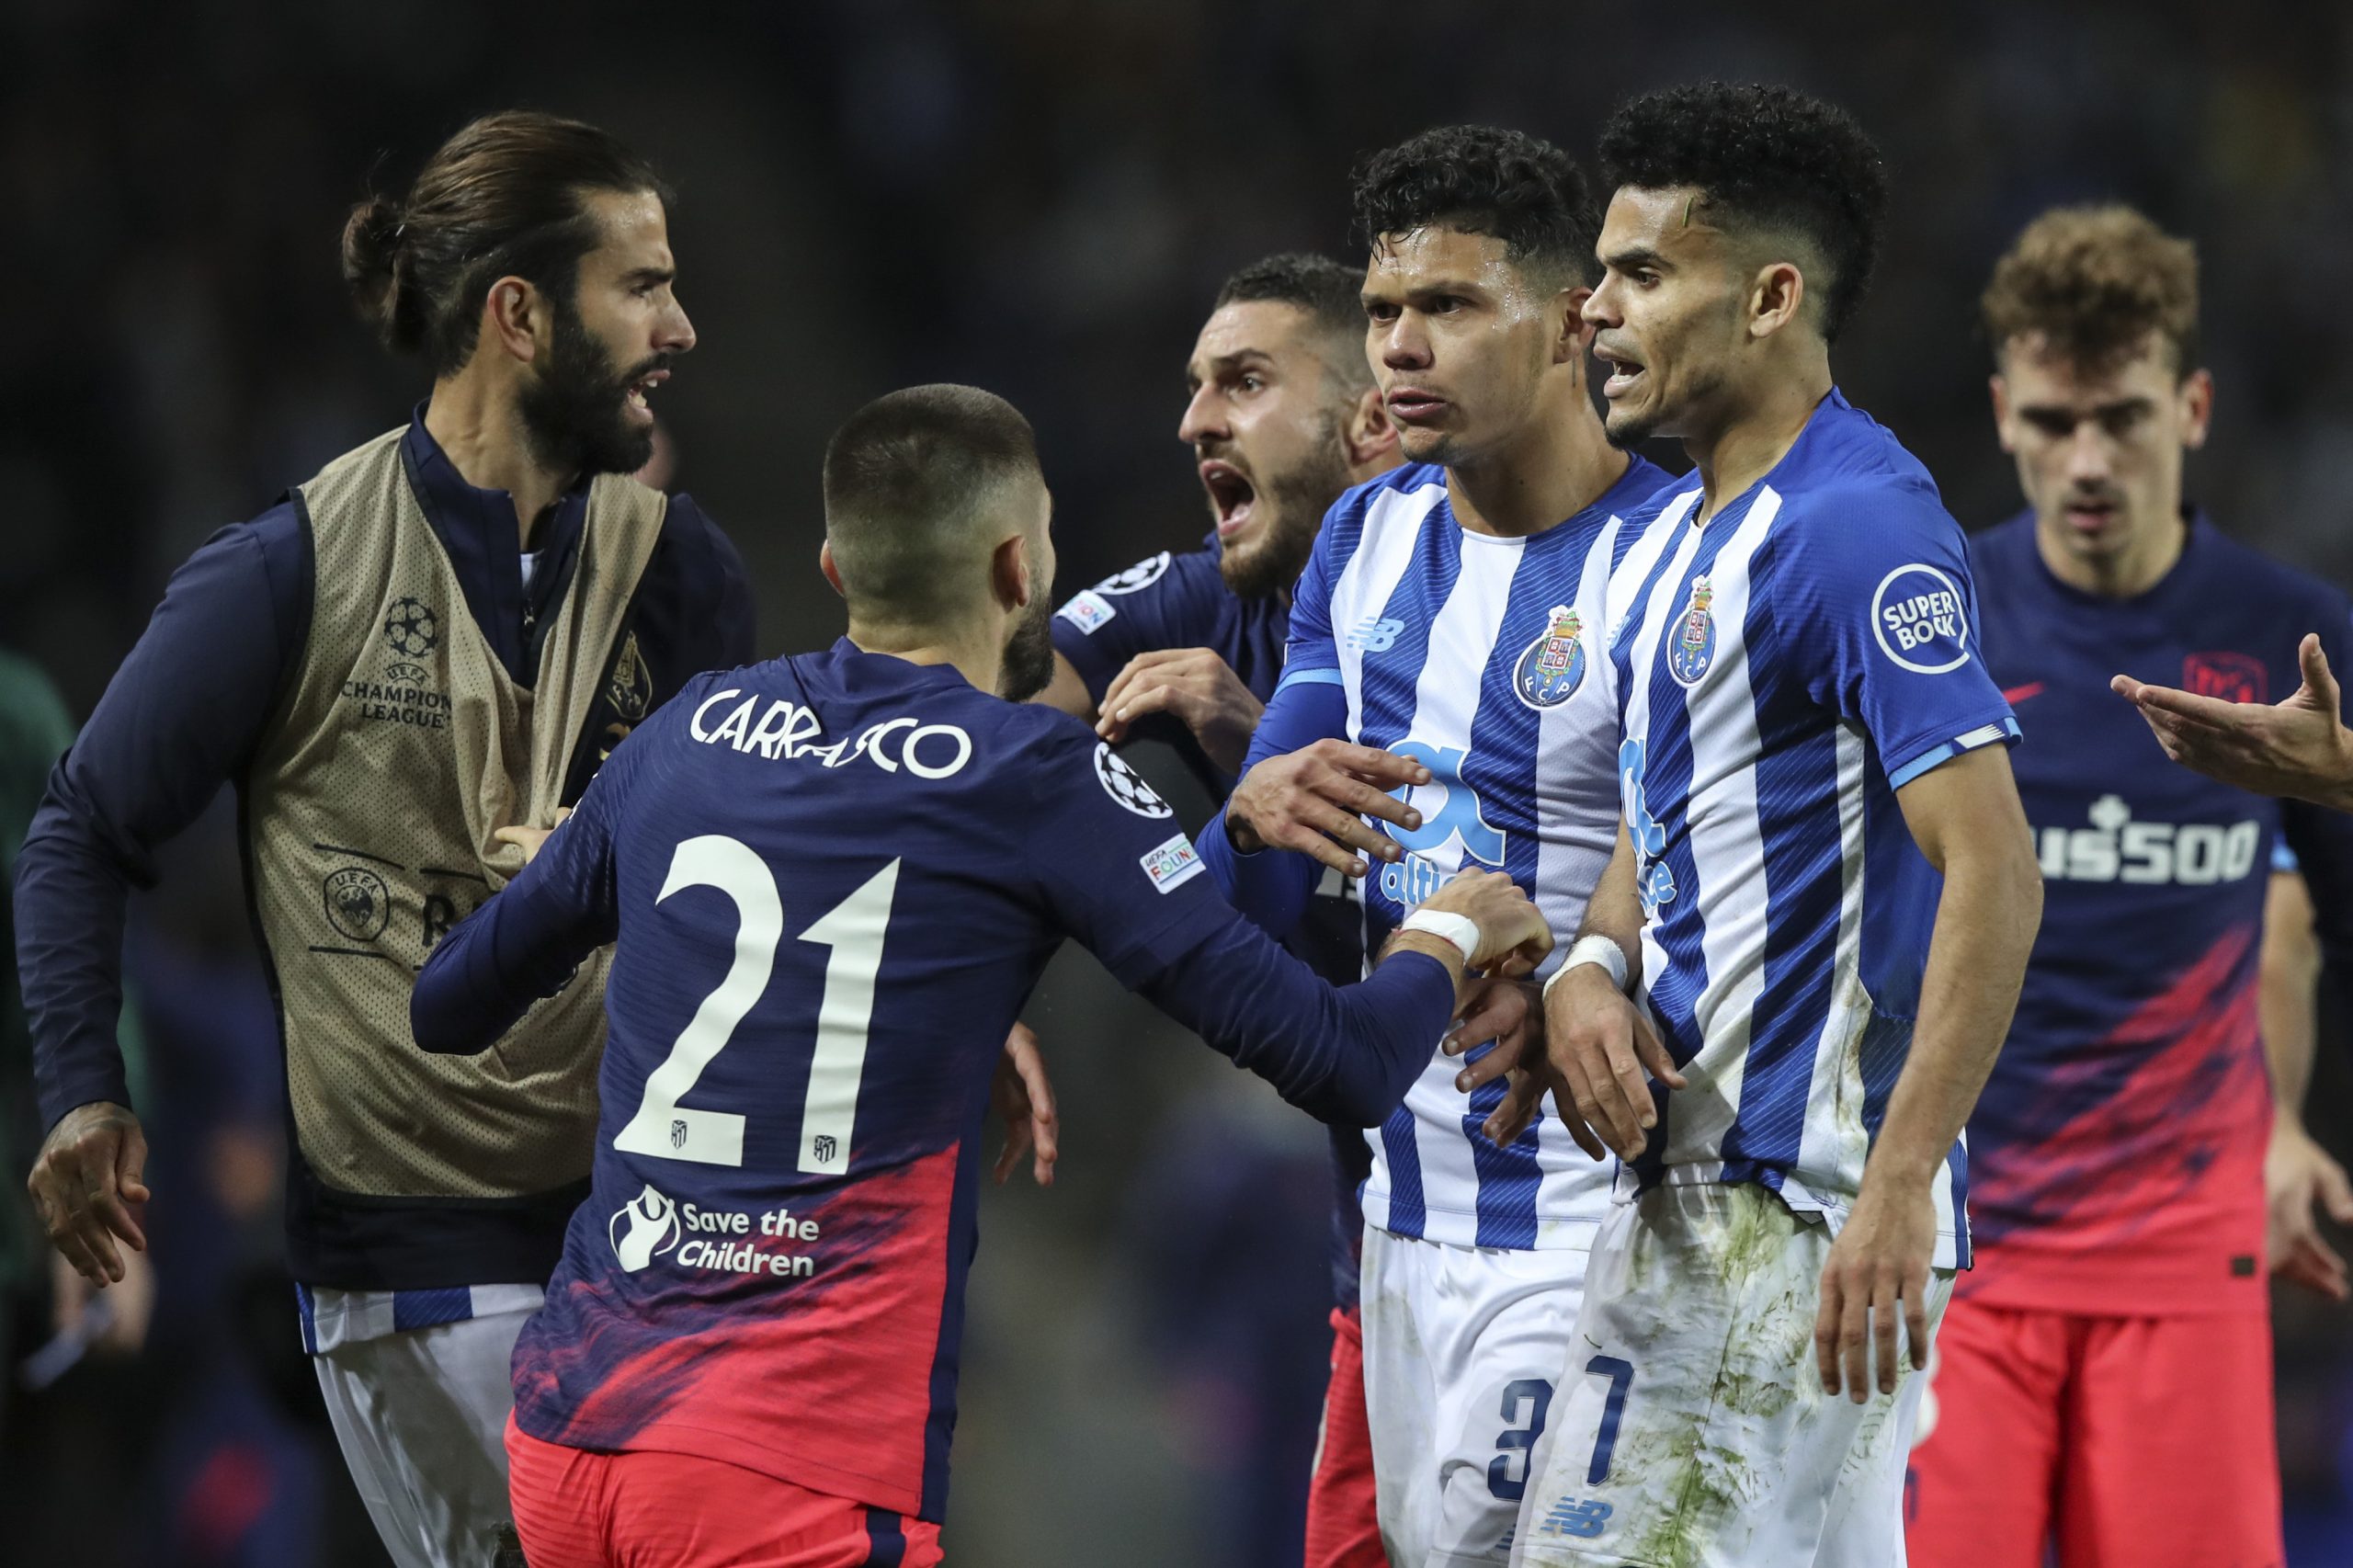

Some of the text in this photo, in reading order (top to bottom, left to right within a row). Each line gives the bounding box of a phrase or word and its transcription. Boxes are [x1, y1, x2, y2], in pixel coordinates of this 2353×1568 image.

[1883, 591, 1955, 631] SUPER
[1895, 614, 1956, 651] BOCK
[387, 666, 426, 684] UEFA
[341, 681, 452, 711] CHAMPION
[362, 703, 444, 729] LEAGUE
[690, 688, 972, 779] CARRASCO
[2029, 819, 2260, 885] us500
[335, 874, 378, 895] UEFA
[613, 835, 901, 1176] 21
[683, 1204, 819, 1241] Save the
[677, 1241, 813, 1277] Children
[1586, 1355, 1636, 1486] 7
